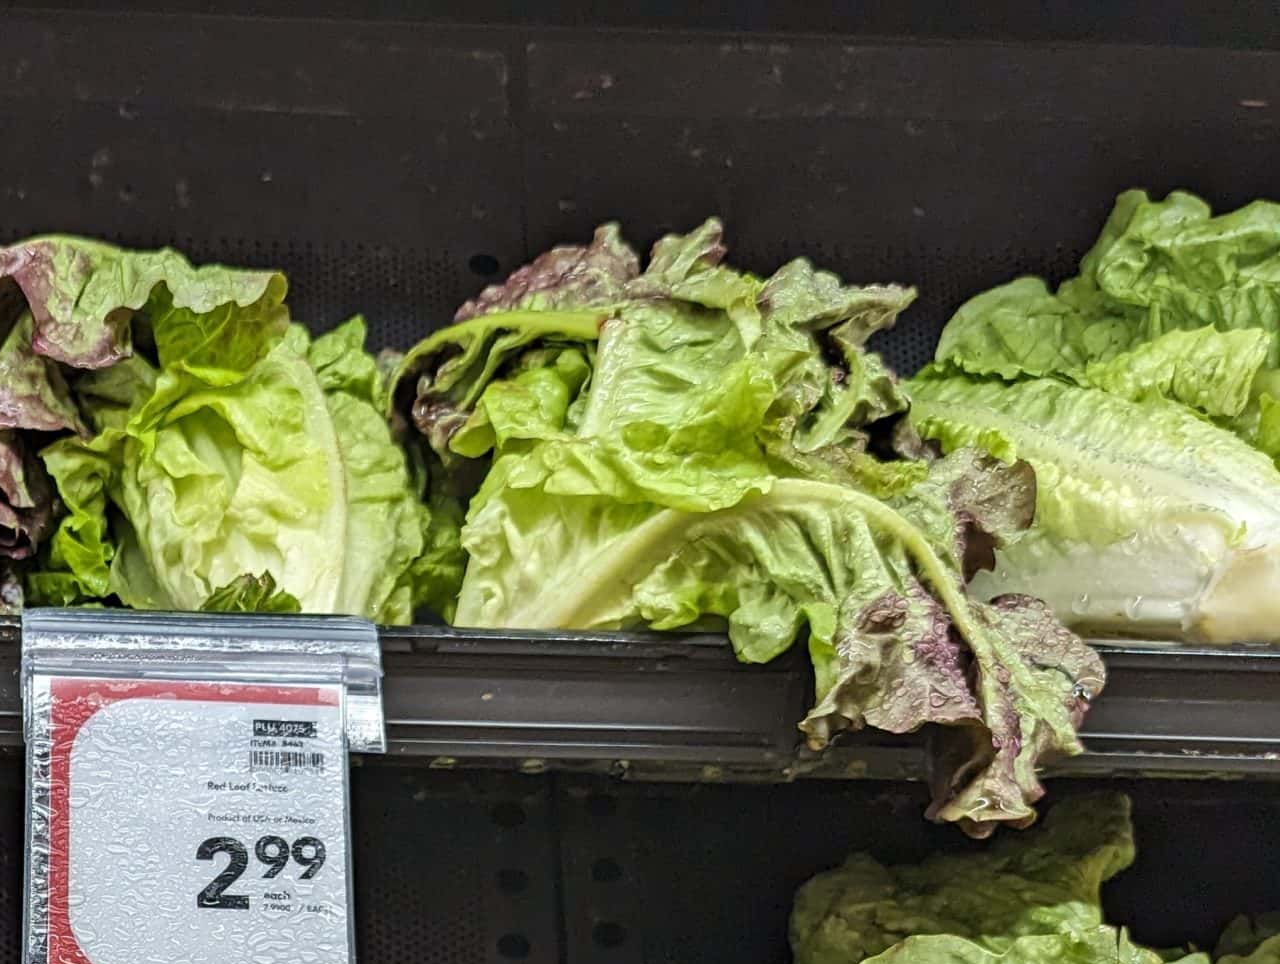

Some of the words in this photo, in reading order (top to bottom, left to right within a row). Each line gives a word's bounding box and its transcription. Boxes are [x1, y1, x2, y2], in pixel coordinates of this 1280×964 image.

[207, 781, 226, 791] Red
[228, 782, 251, 792] Leaf
[207, 812, 240, 822] Product
[242, 814, 251, 823] of
[263, 890, 291, 900] each
